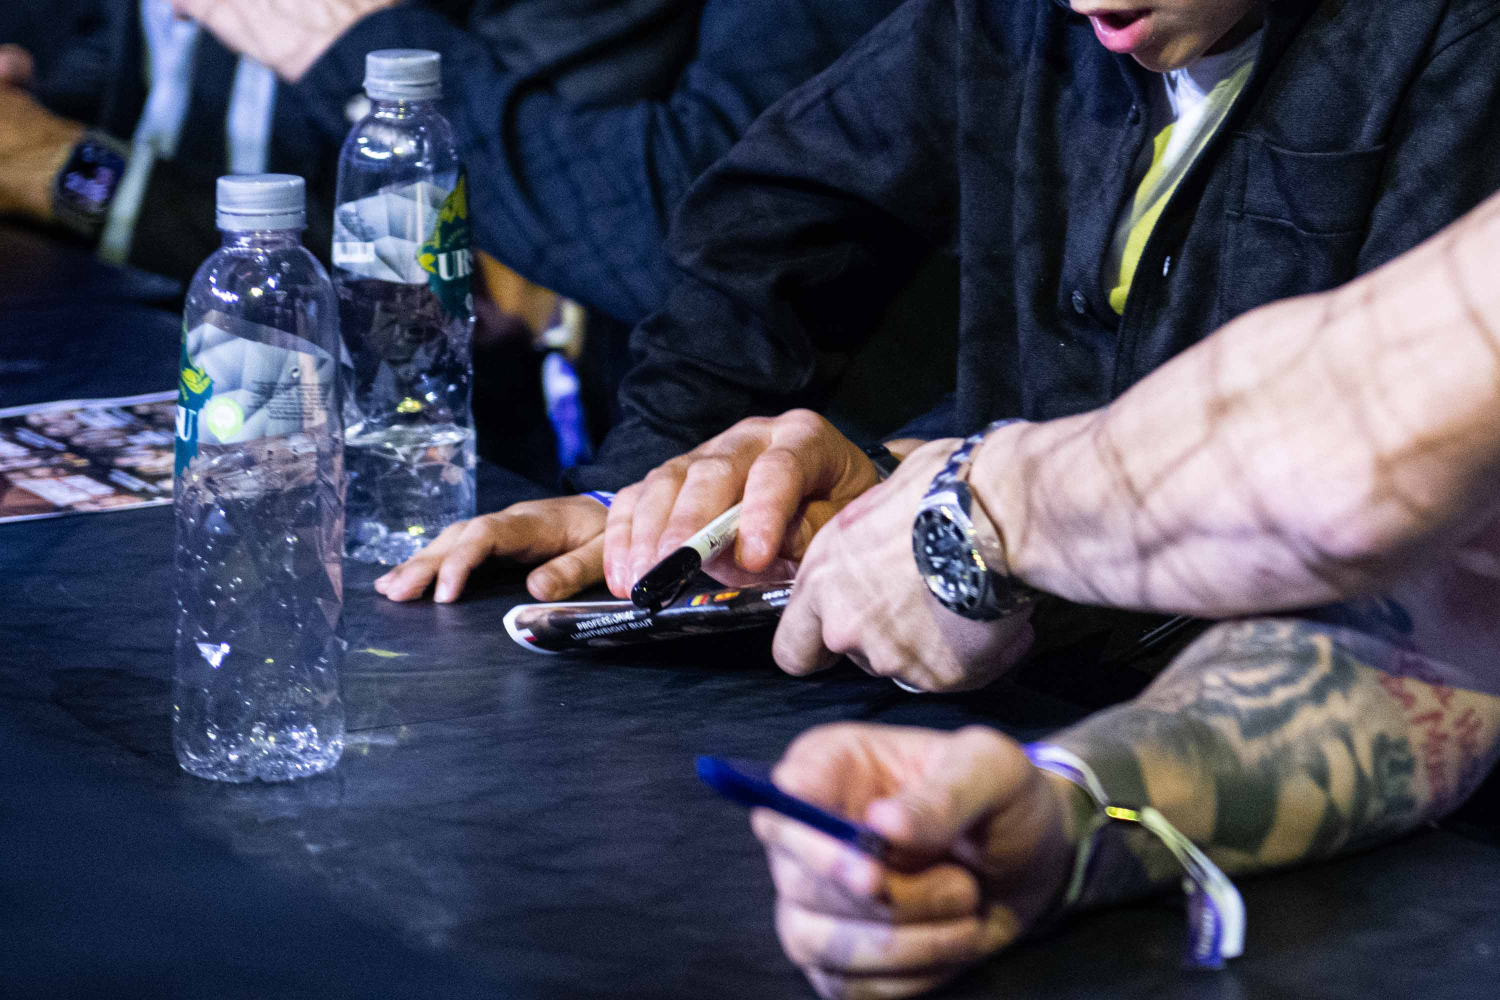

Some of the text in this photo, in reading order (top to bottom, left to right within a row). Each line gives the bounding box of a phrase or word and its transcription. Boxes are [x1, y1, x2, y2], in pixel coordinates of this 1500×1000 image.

[569, 617, 653, 641] LIGHTWEIGHT BOUT
[575, 610, 635, 632] PROFESSIONAL
